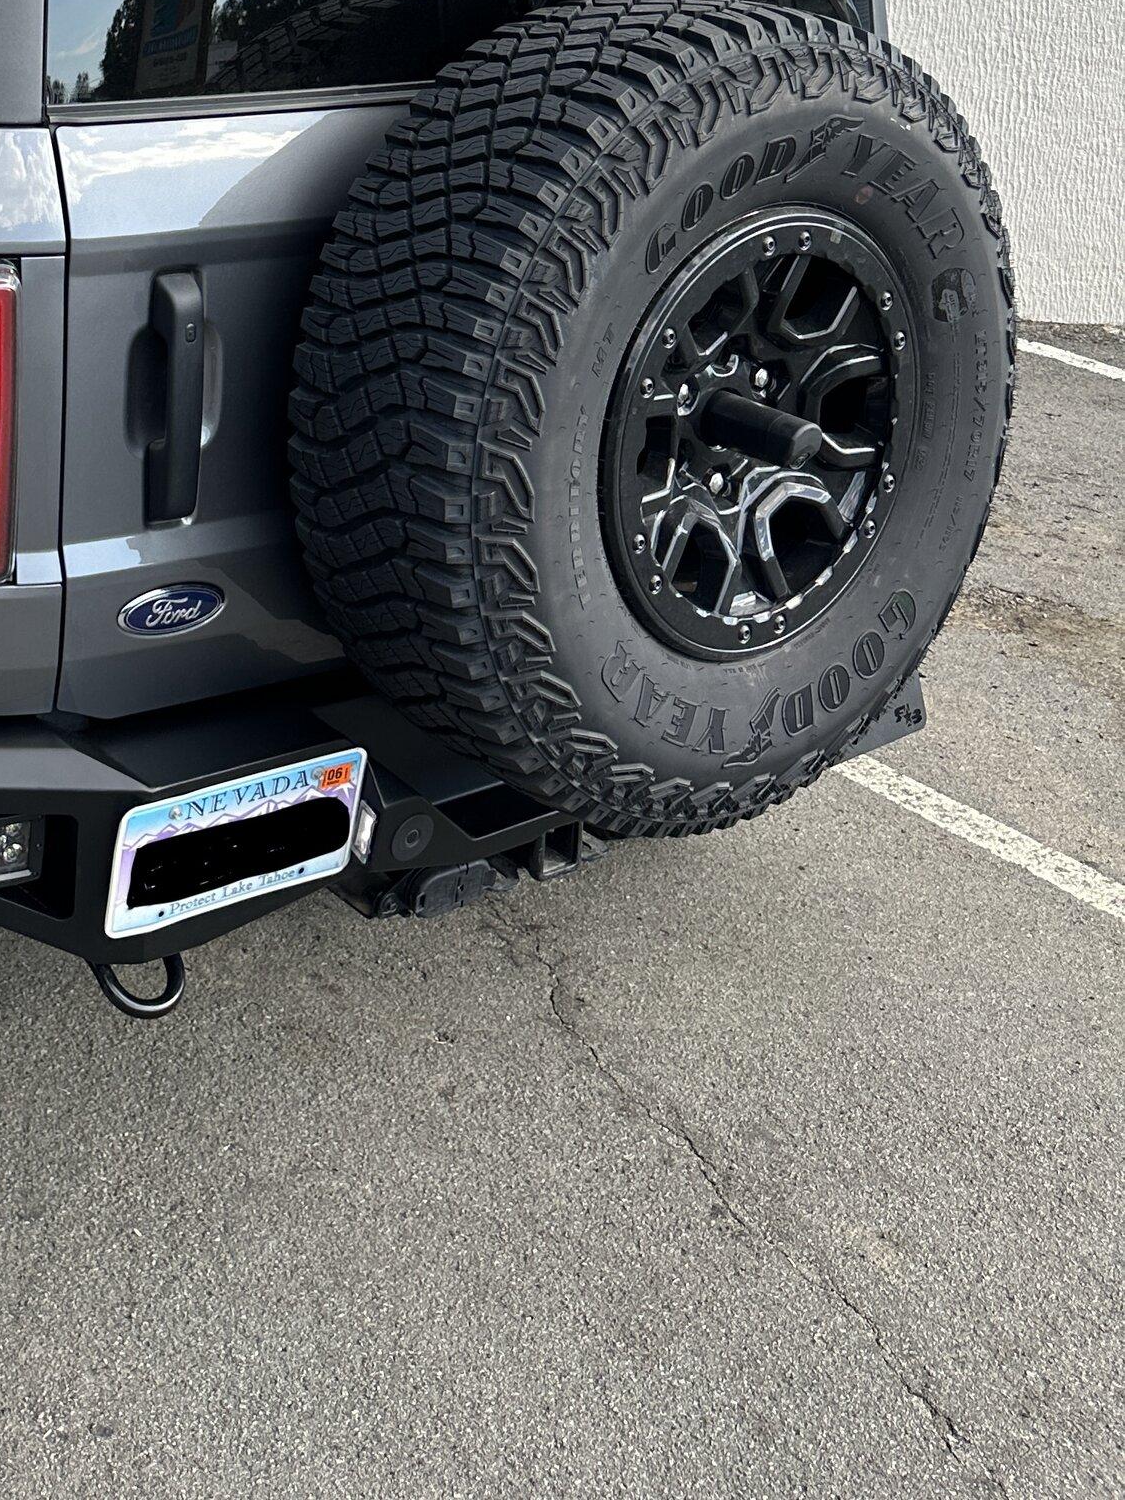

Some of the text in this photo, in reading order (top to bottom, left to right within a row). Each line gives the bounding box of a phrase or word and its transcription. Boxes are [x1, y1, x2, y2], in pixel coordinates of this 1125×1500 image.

[145, 596, 202, 628] Ford
[185, 770, 310, 820] NEVADA
[169, 867, 296, 915] Protect Lake Tahoe
